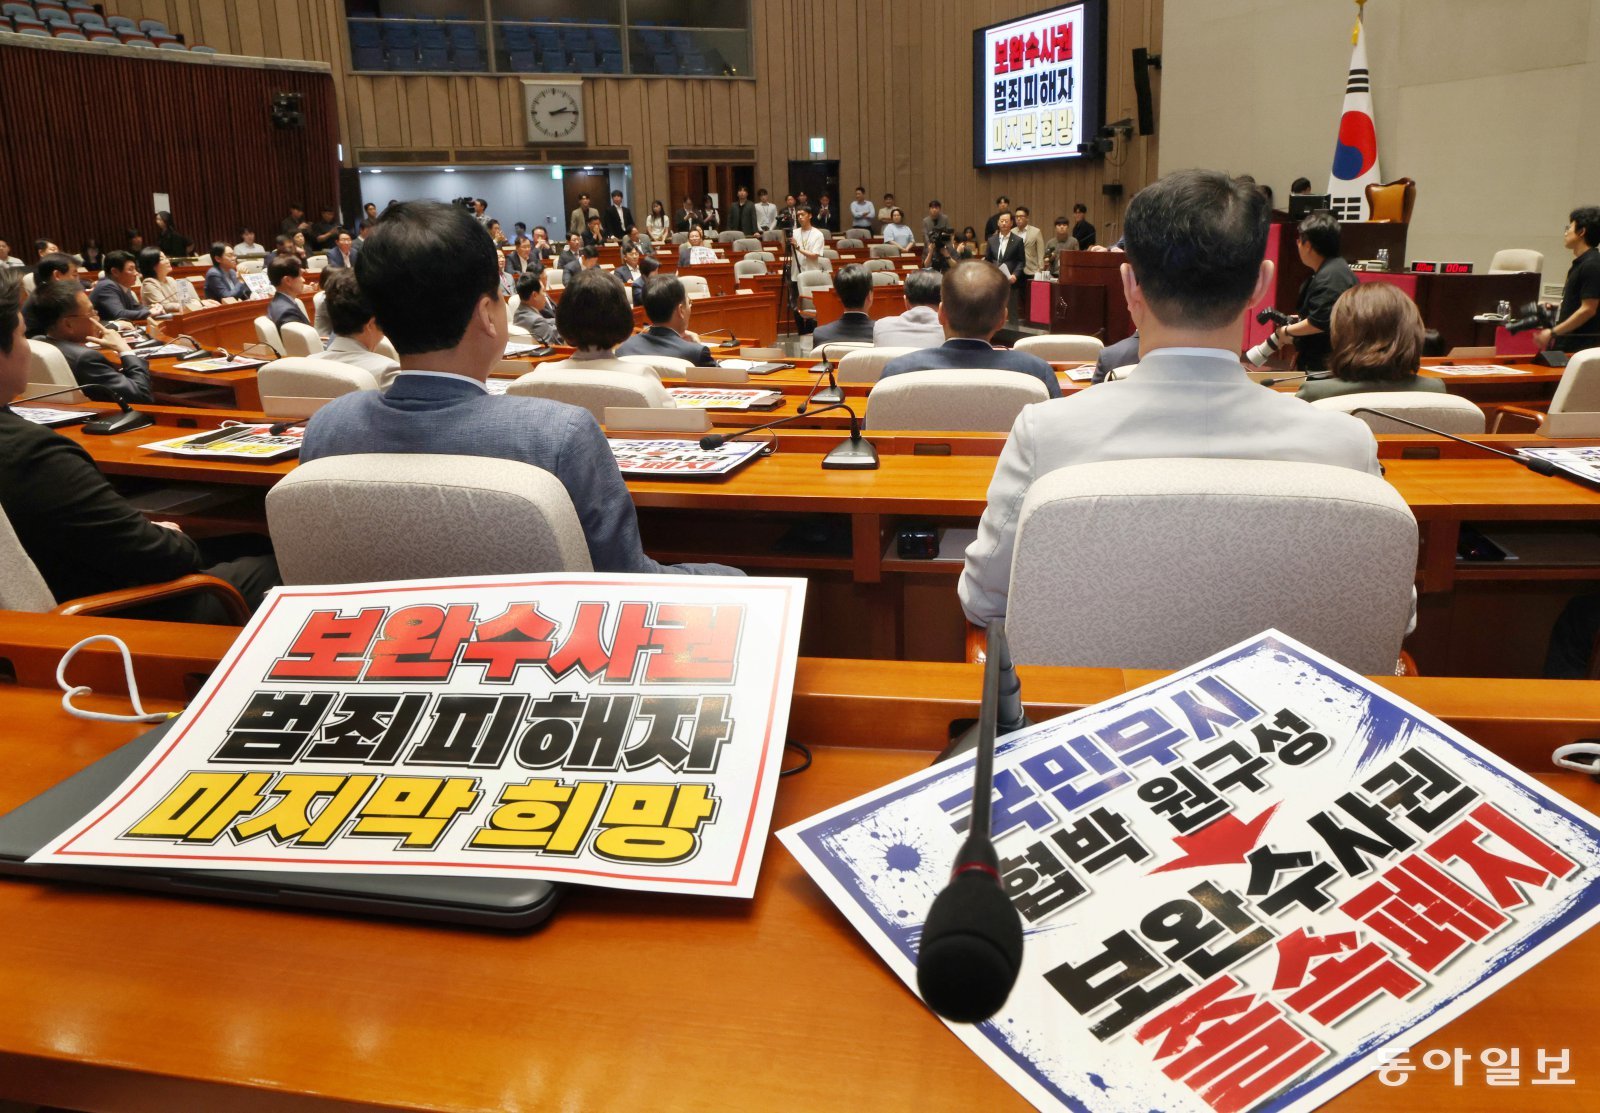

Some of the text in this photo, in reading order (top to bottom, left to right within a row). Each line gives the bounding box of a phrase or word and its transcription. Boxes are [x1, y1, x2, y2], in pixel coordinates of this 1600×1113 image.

[993, 67, 1074, 113] 범죄피해자
[994, 22, 1073, 75] 보완수사권
[993, 107, 1074, 152] 마지막 희망
[263, 602, 747, 684] 보완수사권
[208, 691, 734, 773] 범죄피해자
[938, 675, 1263, 838] 국민무시
[116, 771, 723, 866] 마지막 희망
[1003, 707, 1330, 923] 협박 원구성
[1043, 748, 1478, 1042] 보완수사권
[1133, 802, 1577, 1113] 졸속폐지
